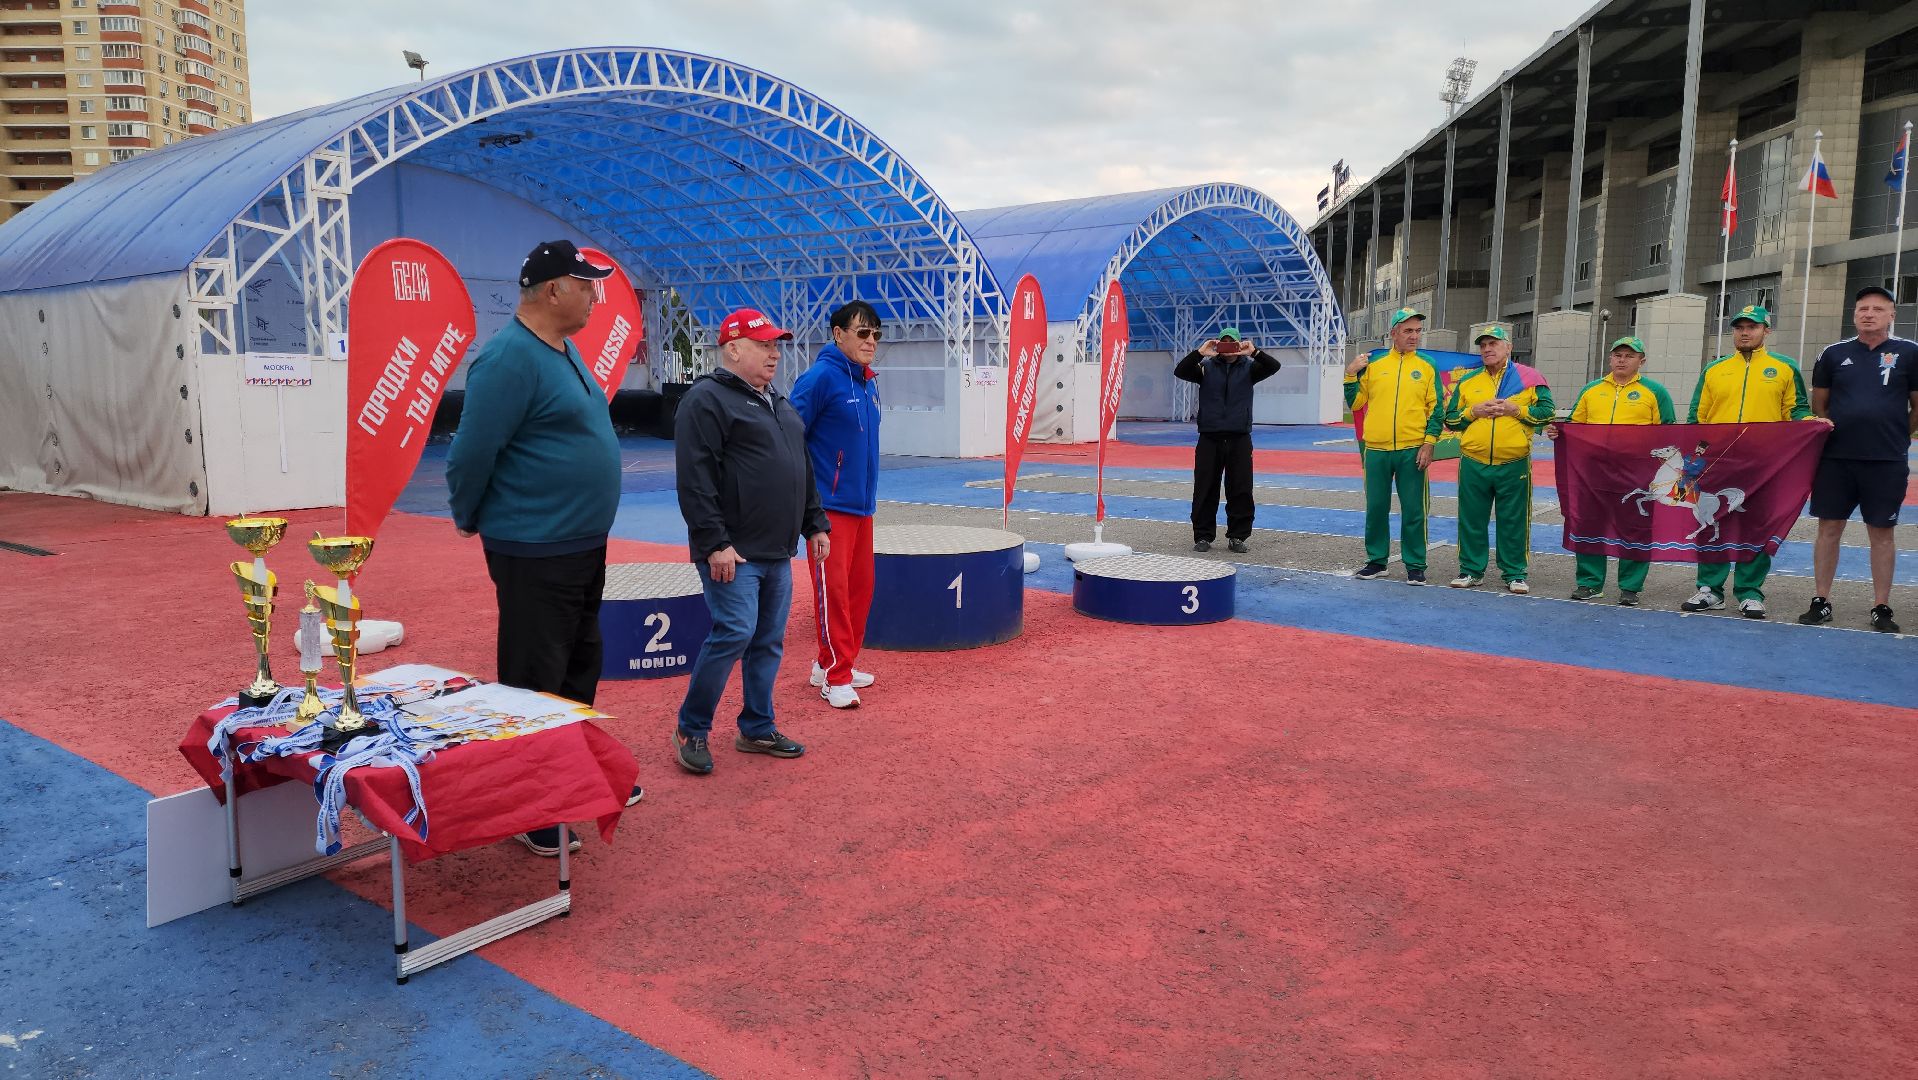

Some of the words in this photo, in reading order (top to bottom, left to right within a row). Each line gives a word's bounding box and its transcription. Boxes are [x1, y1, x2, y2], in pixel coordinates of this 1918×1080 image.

[429, 322, 466, 376] ИГРЕ
[594, 314, 632, 382] RUSSIA
[263, 364, 295, 372] МОСКВА
[357, 335, 421, 437] ГОРОДКИ
[420, 371, 440, 394] В
[1011, 346, 1028, 403] ДОБРО
[1881, 367, 1891, 386] 1
[405, 387, 433, 425] ТЫ
[1012, 342, 1042, 444] ПОЖАЛОВАТЬ
[946, 571, 963, 609] 1
[1180, 585, 1200, 615] 3
[643, 612, 672, 653] 2
[629, 655, 687, 670] MONDO
